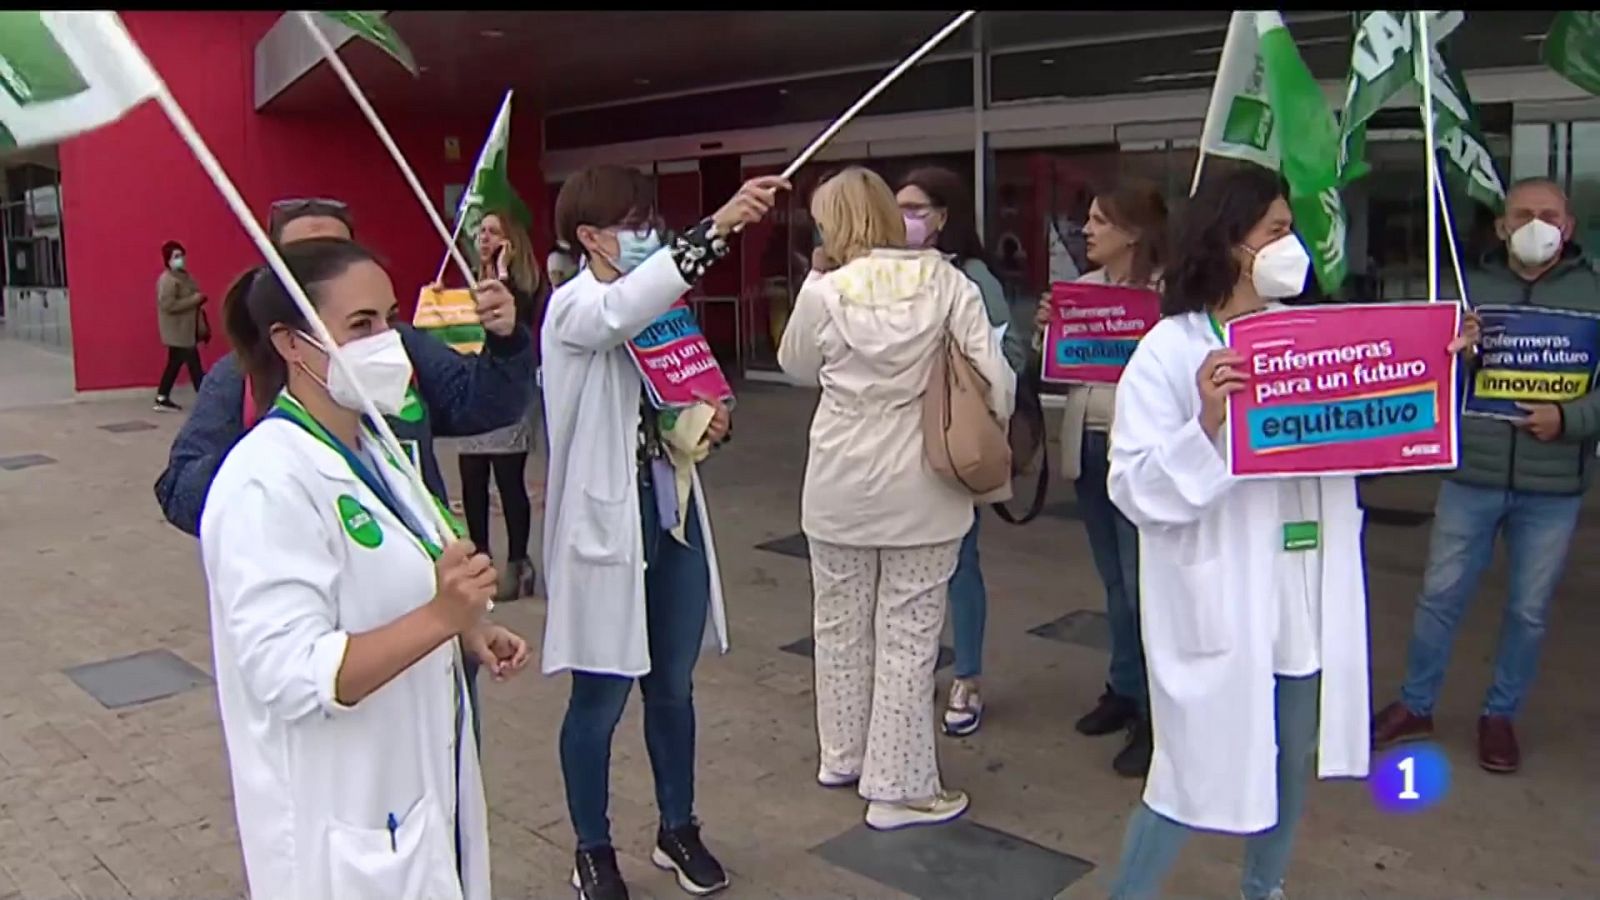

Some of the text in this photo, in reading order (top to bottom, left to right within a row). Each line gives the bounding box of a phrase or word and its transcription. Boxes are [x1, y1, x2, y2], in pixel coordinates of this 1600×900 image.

[1481, 333, 1571, 350] Enfermeras
[1252, 340, 1393, 376] Enfermeras
[1482, 349, 1590, 367] para un futuro
[1255, 359, 1427, 404] para un futuro
[1482, 375, 1583, 394] innovador
[1261, 402, 1419, 442] equitativo
